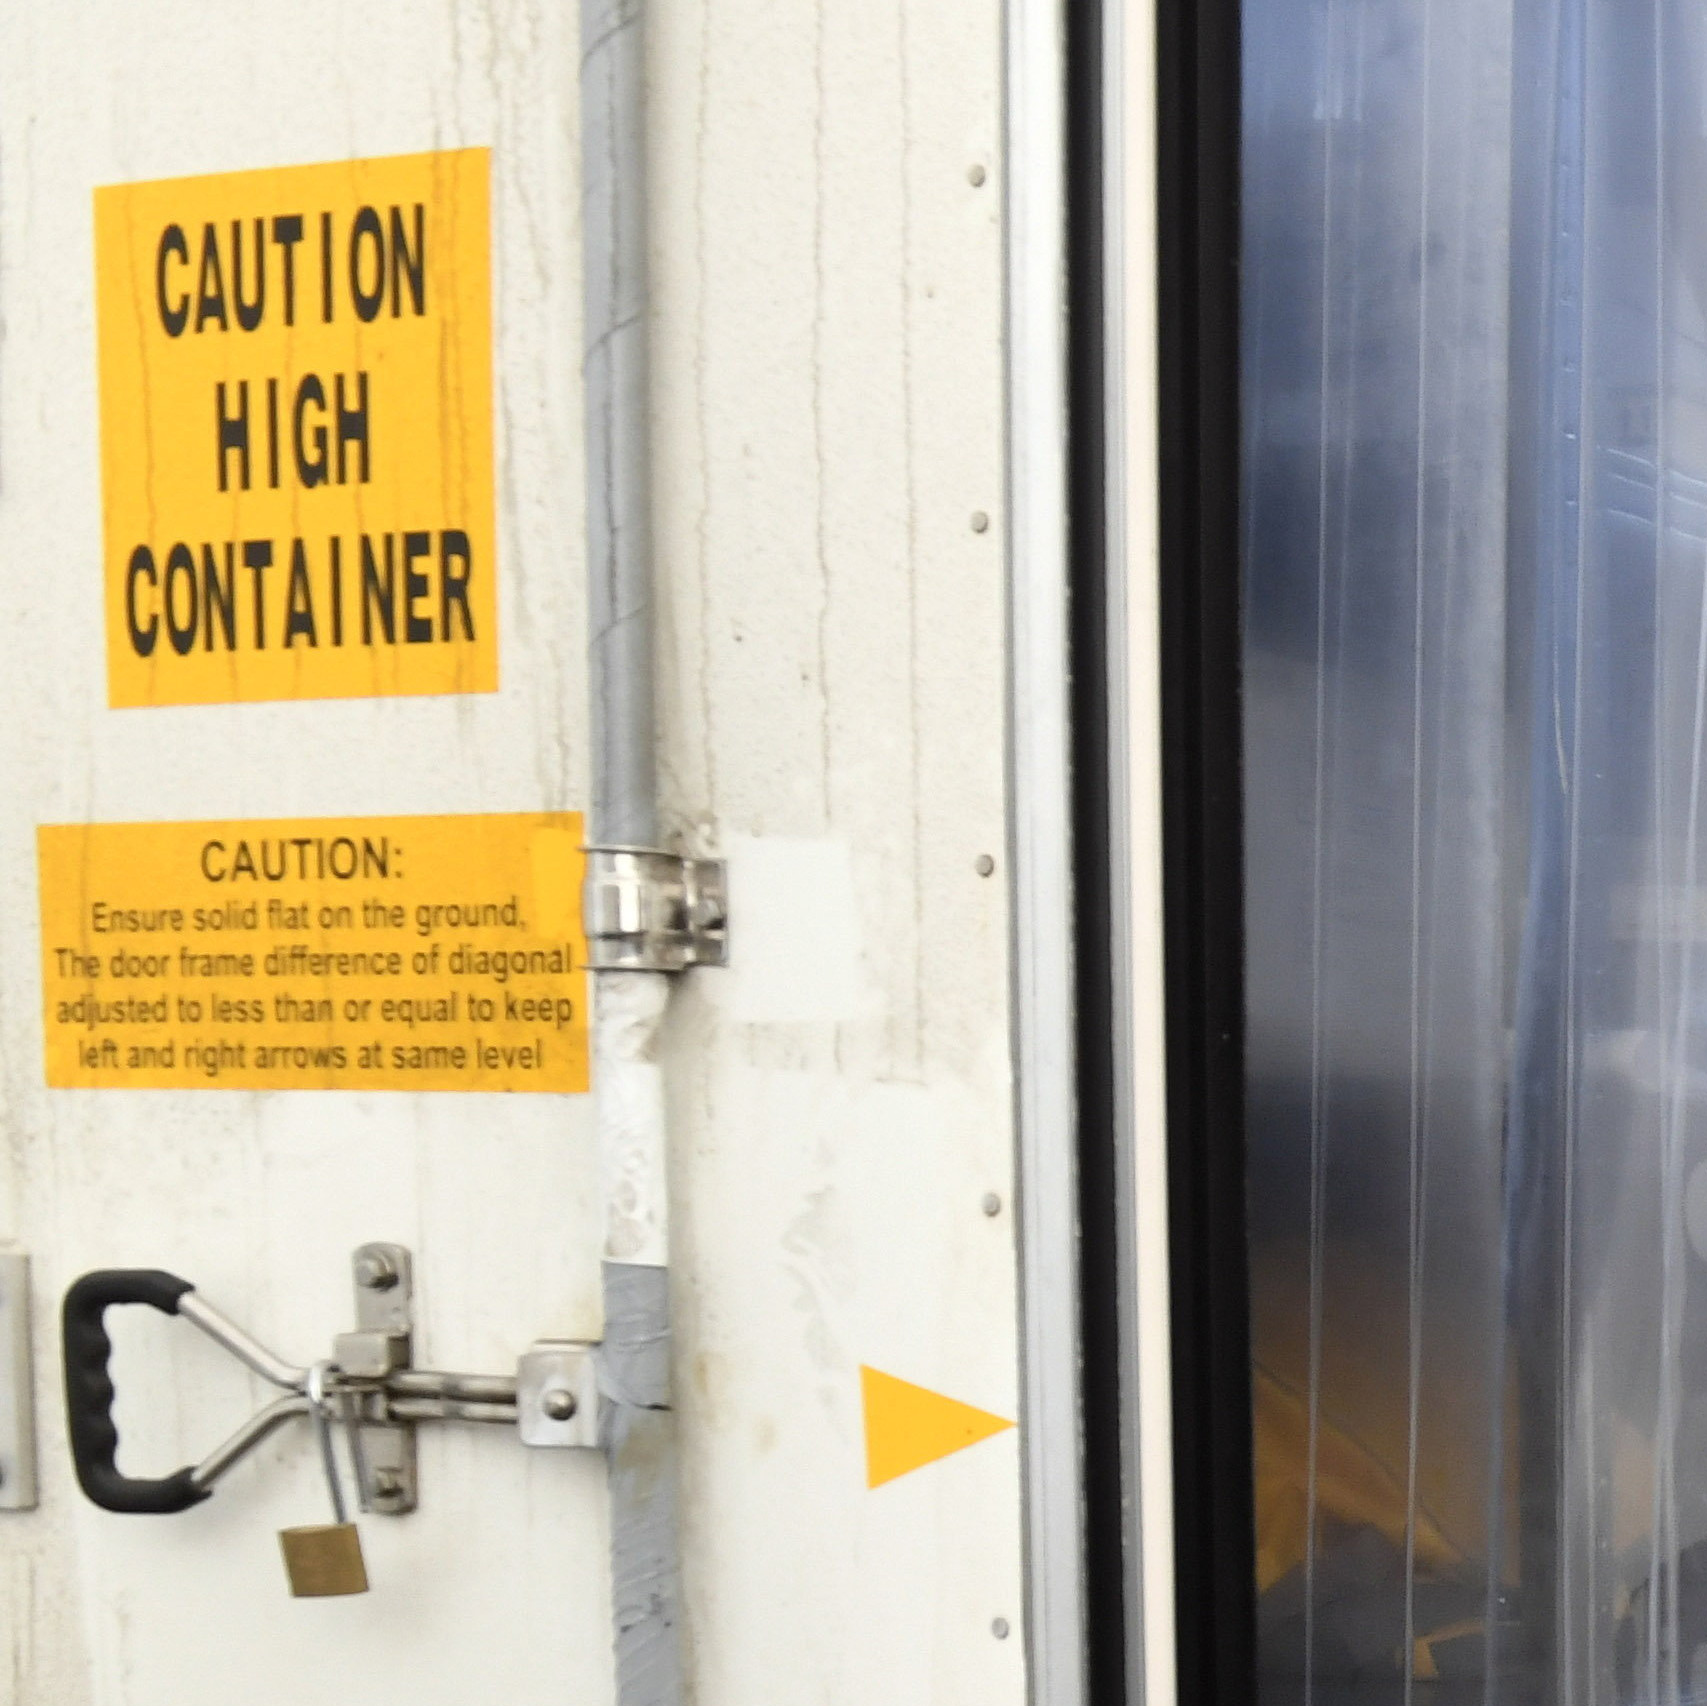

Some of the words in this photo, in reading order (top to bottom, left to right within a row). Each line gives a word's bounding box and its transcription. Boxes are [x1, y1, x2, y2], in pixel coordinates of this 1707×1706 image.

[156, 203, 427, 340] CAUTION
[215, 372, 371, 492] HIGH
[125, 528, 476, 658] CONTAINER
[200, 836, 405, 882] CAUTION:
[92, 902, 183, 932] Ensure
[193, 900, 257, 931] solid
[267, 898, 309, 931] flat
[319, 907, 350, 929] on
[363, 900, 405, 928] the
[55, 948, 100, 978] The
[110, 947, 168, 977] door
[179, 947, 253, 977] frame
[264, 945, 401, 976] difference
[412, 944, 441, 974] of
[449, 943, 572, 982] diagonal
[56, 993, 167, 1031] adjusted
[178, 996, 202, 1022] to
[211, 993, 264, 1022] less
[275, 993, 332, 1022] than
[343, 1000, 370, 1021] or
[381, 992, 457, 1030] equal
[468, 993, 496, 1021] to
[506, 992, 573, 1029] keep
[79, 1039, 117, 1069] left
[127, 1040, 174, 1069] and
[184, 1040, 245, 1077] right
[255, 1044, 346, 1070] arrows
[357, 1043, 382, 1069] at
[392, 1045, 465, 1069] same
[476, 1038, 542, 1069] level
